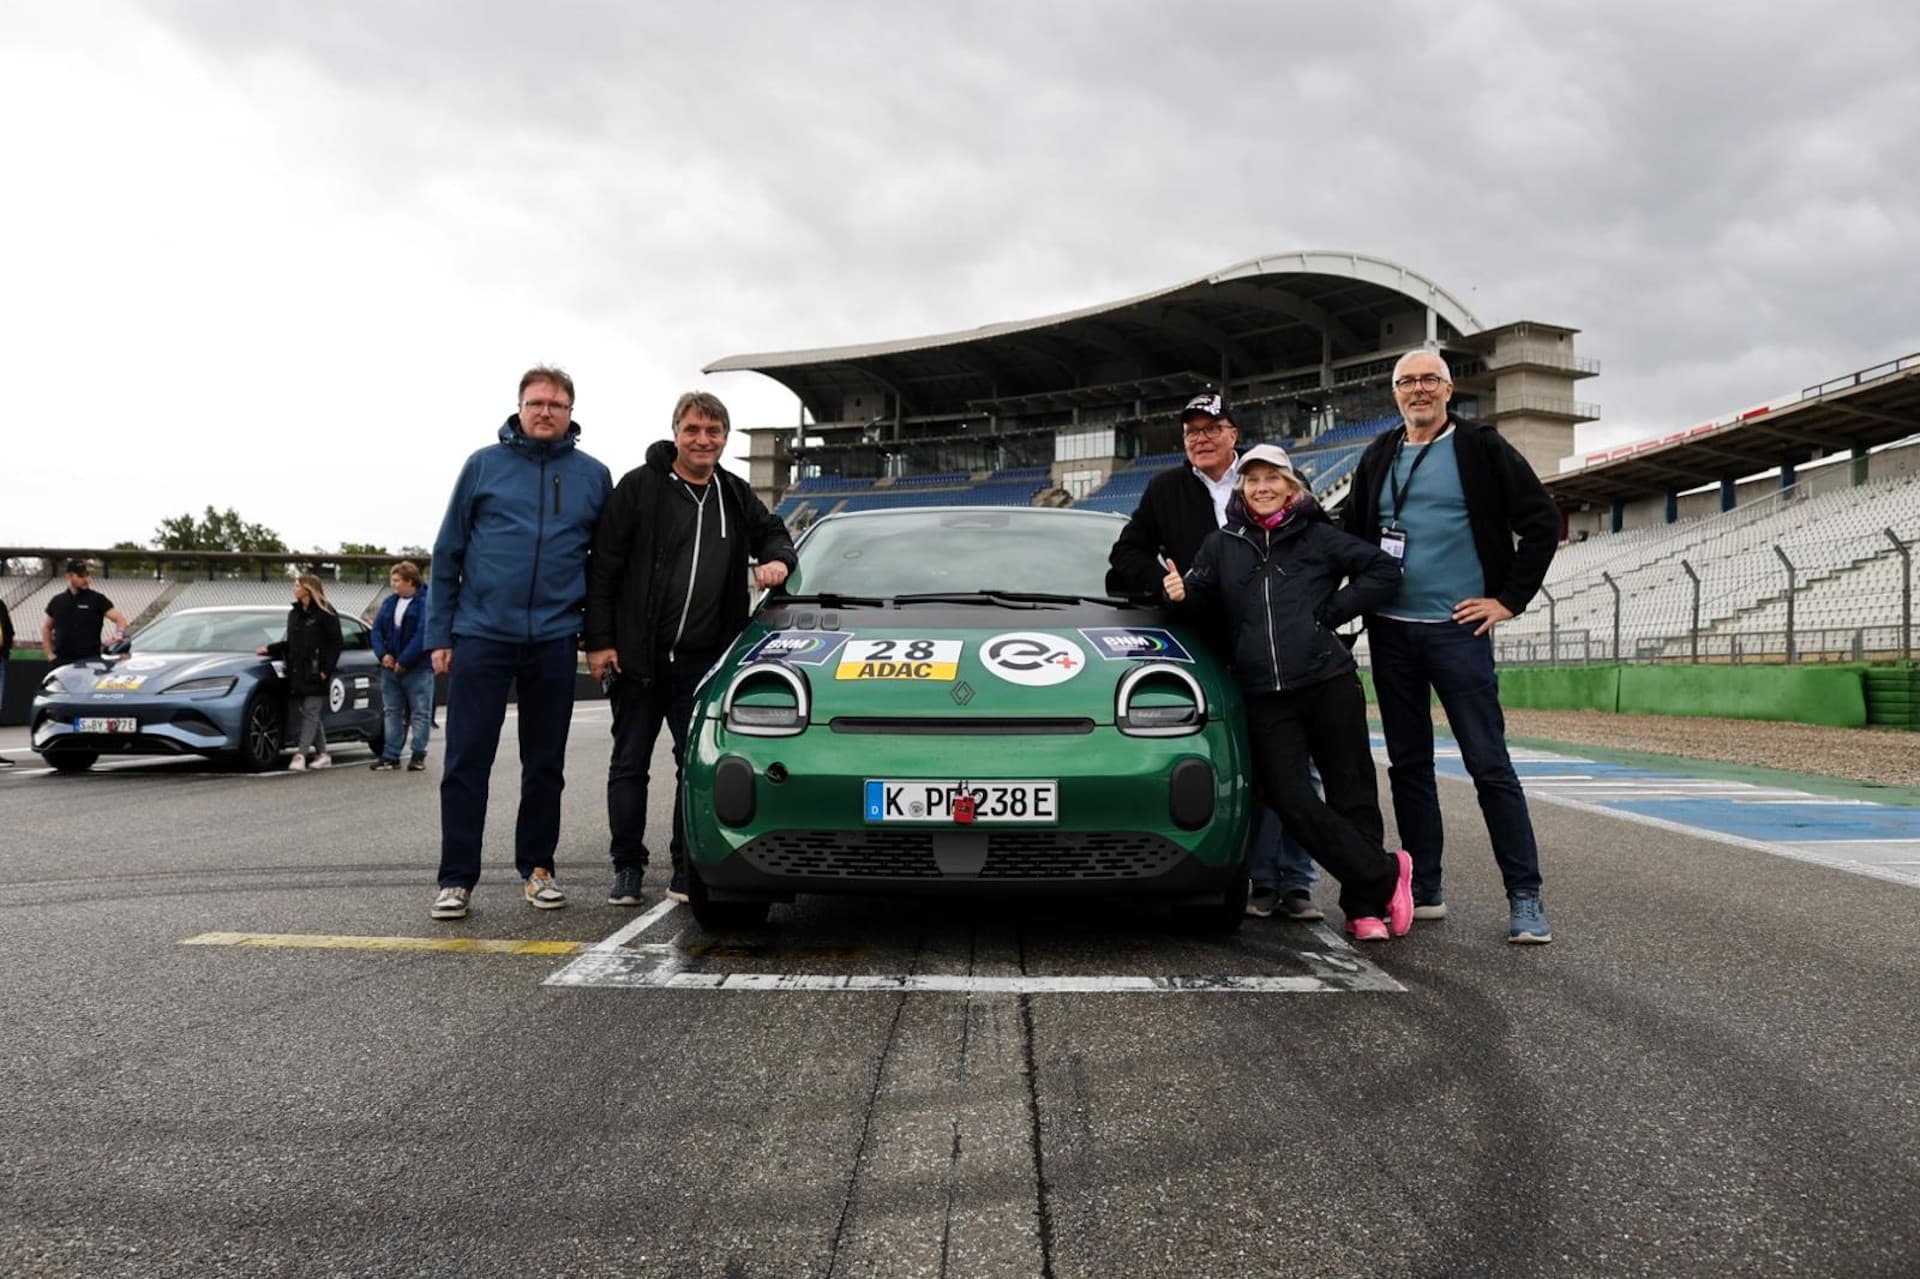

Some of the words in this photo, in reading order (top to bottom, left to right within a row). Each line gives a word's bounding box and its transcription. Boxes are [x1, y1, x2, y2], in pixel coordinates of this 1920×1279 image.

[865, 640, 935, 660] 28
[858, 663, 933, 678] ADAC
[886, 787, 904, 816] K
